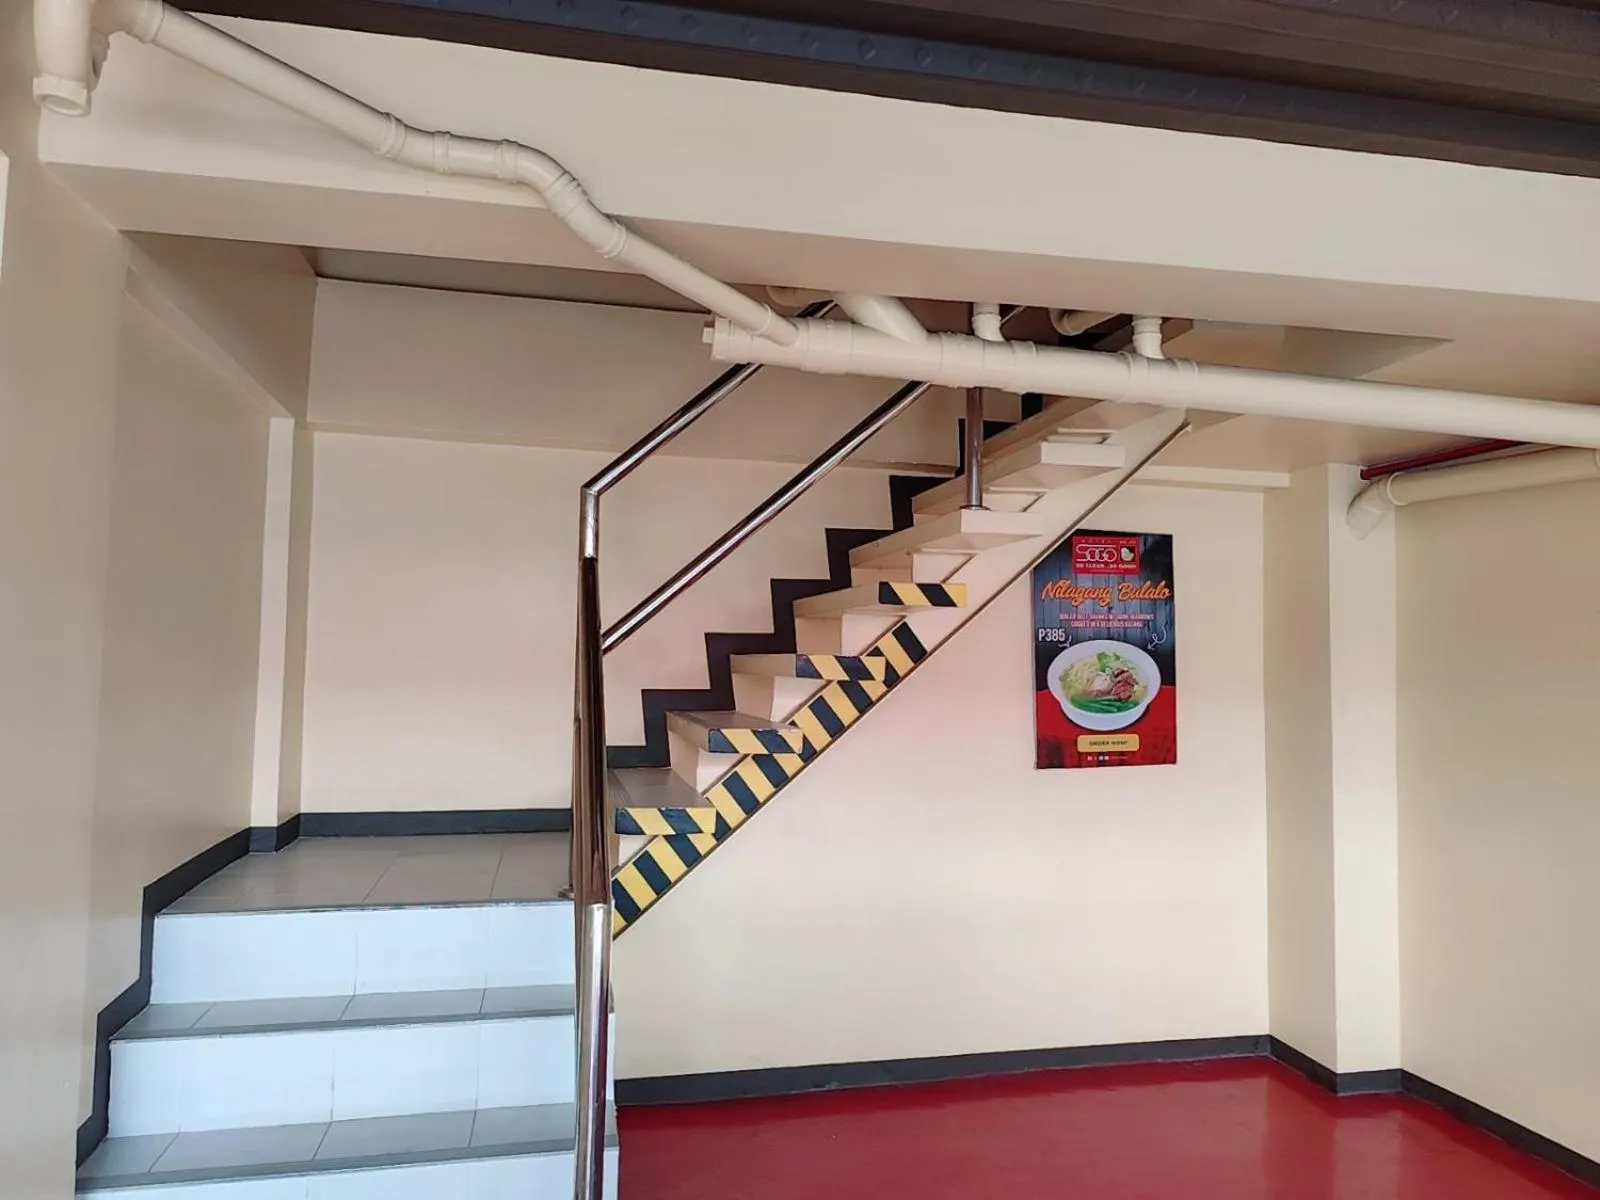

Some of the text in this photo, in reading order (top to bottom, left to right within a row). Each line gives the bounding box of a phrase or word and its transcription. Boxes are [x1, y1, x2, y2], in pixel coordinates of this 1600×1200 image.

[1076, 544, 1117, 562] SOGO
[1041, 579, 1172, 606] Nilagang Bulalo
[1038, 628, 1066, 642] P385
